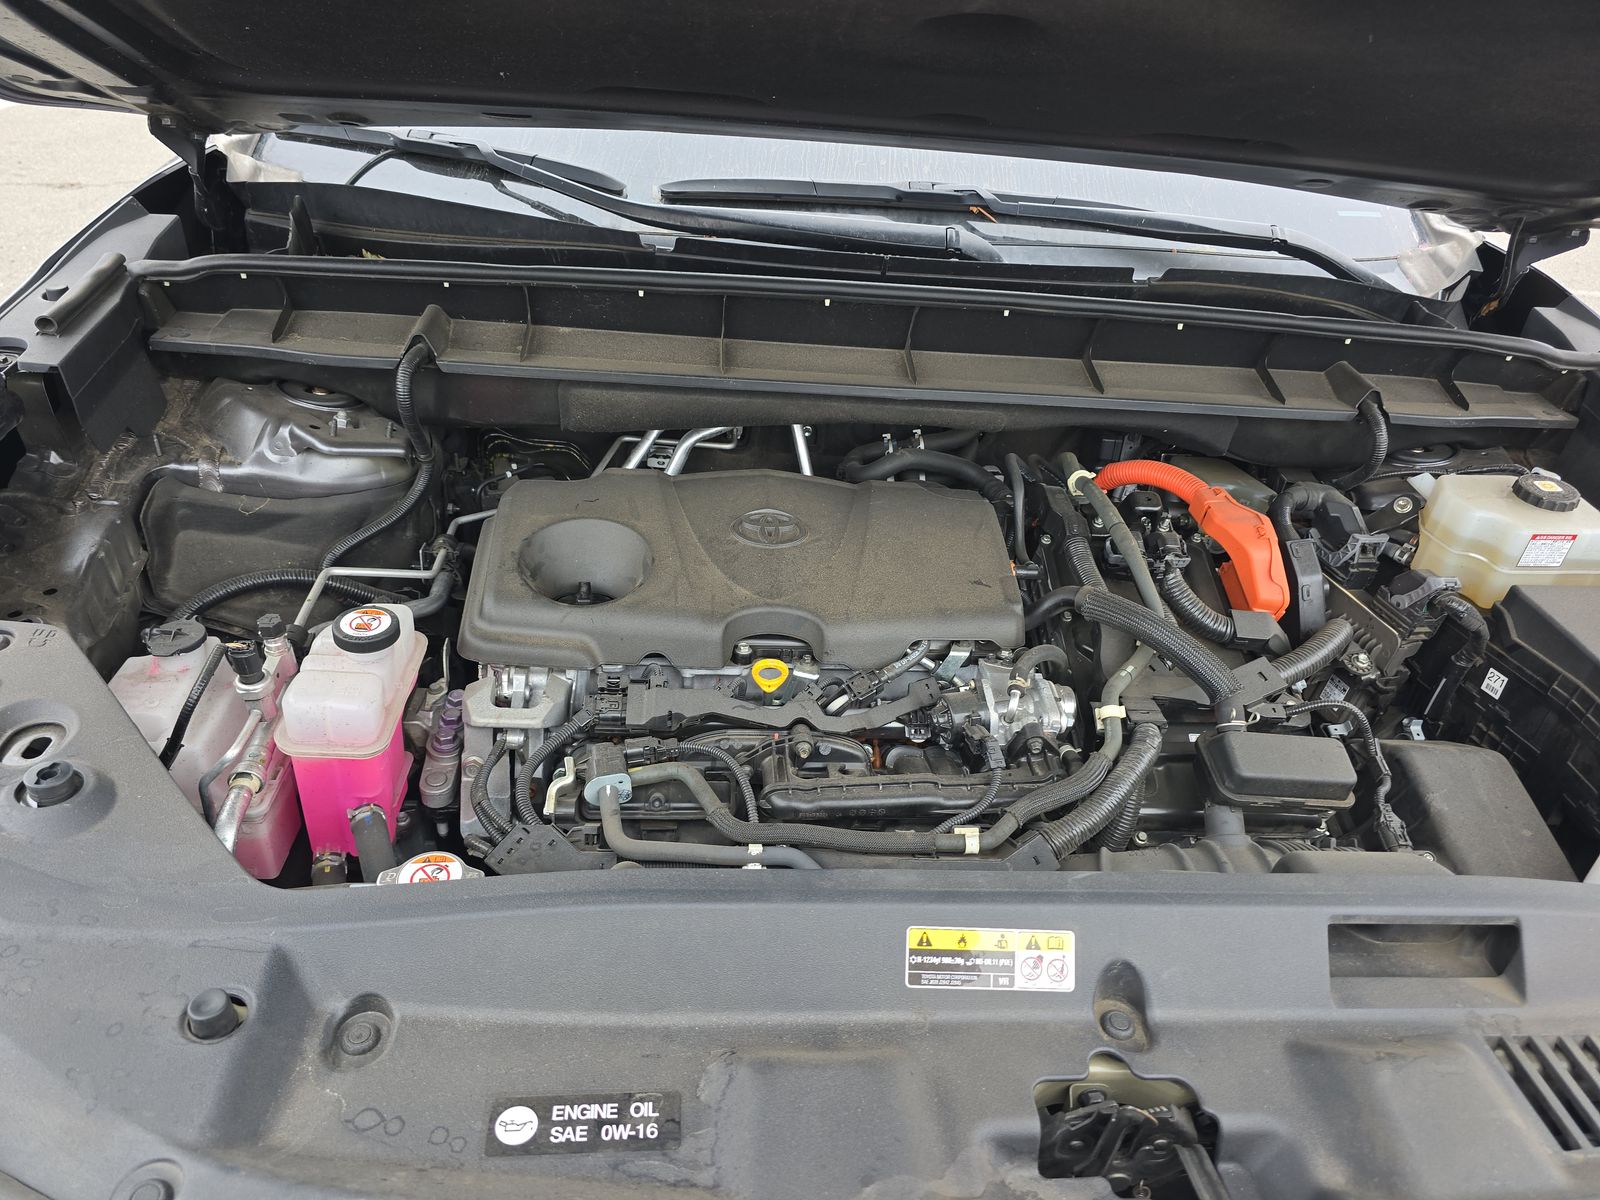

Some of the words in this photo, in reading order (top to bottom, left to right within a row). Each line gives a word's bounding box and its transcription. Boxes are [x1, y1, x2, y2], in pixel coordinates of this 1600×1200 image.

[1488, 671, 1505, 688] 271
[551, 1103, 618, 1121] ENGINE
[630, 1101, 659, 1118] OIL
[549, 1126, 588, 1143] SAE
[601, 1123, 659, 1141] 0W-16
